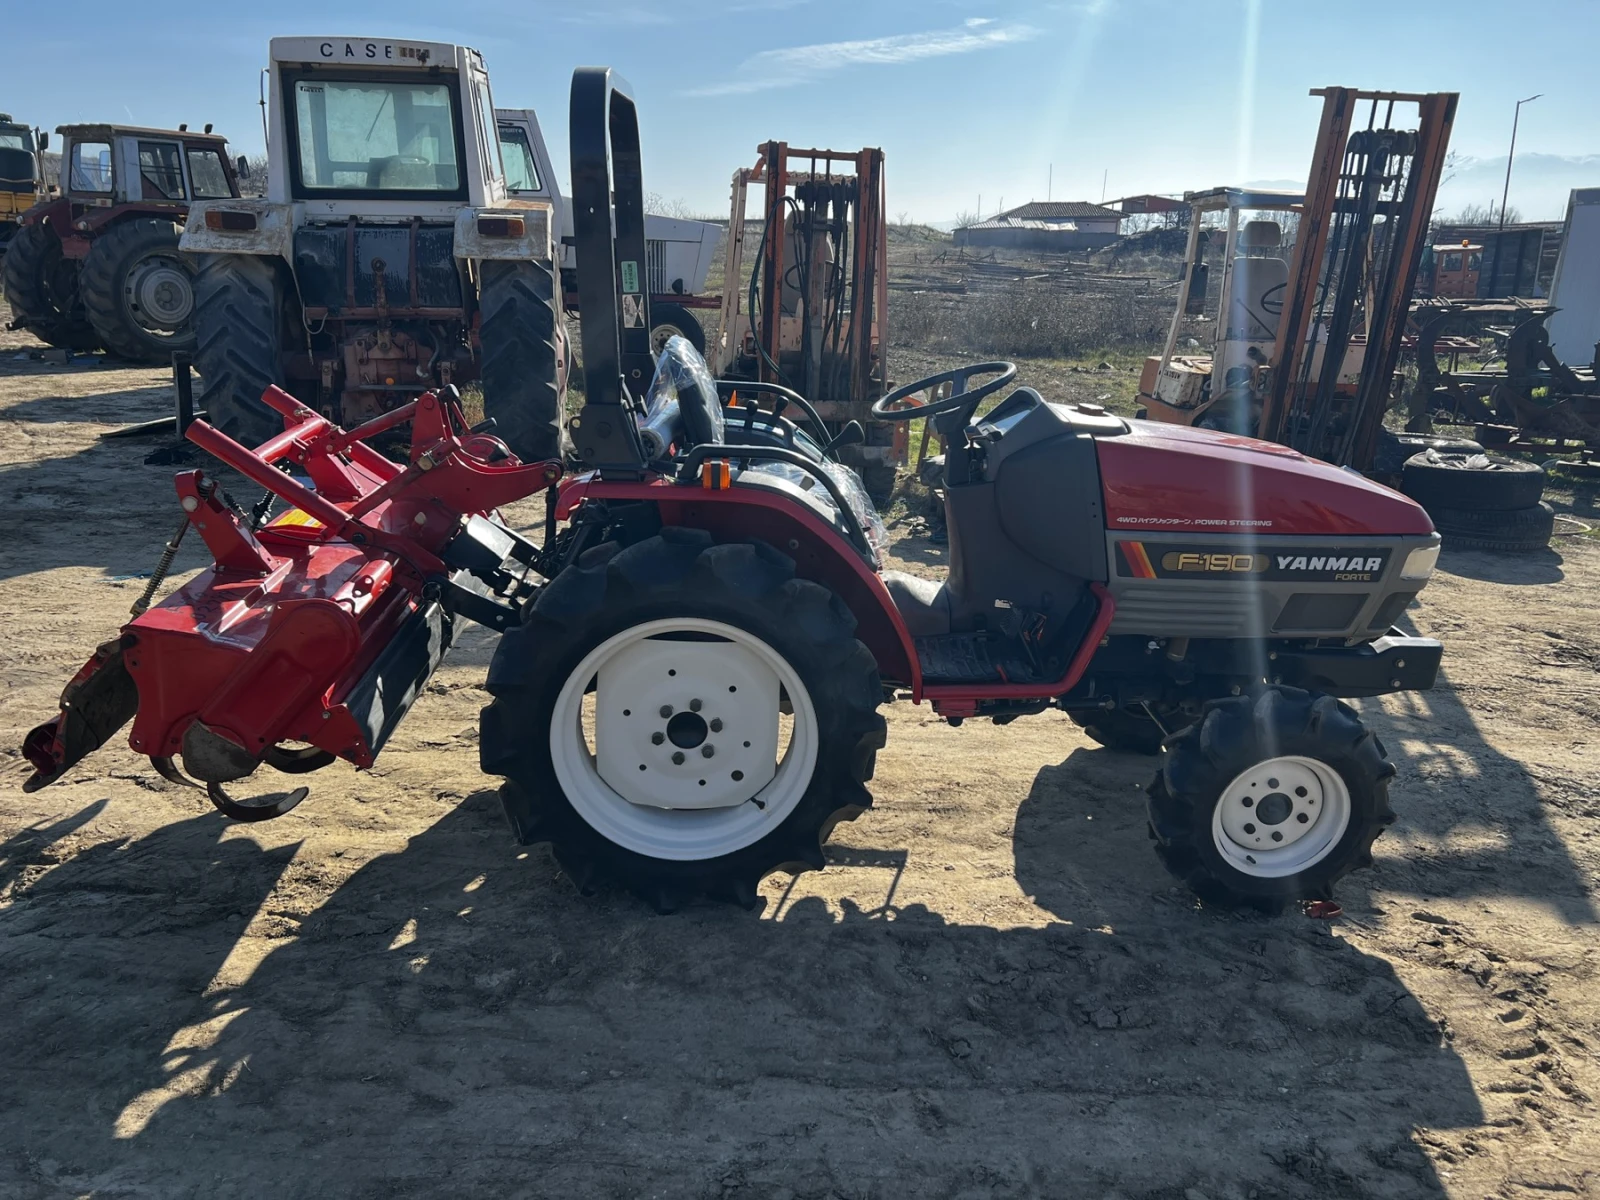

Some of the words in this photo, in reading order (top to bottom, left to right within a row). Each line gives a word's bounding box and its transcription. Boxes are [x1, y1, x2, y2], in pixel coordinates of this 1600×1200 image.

[320, 42, 392, 59] CASE
[1228, 519, 1273, 527] STEERING
[1276, 556, 1383, 571] YANMAR
[1335, 573, 1371, 581] FORTE
